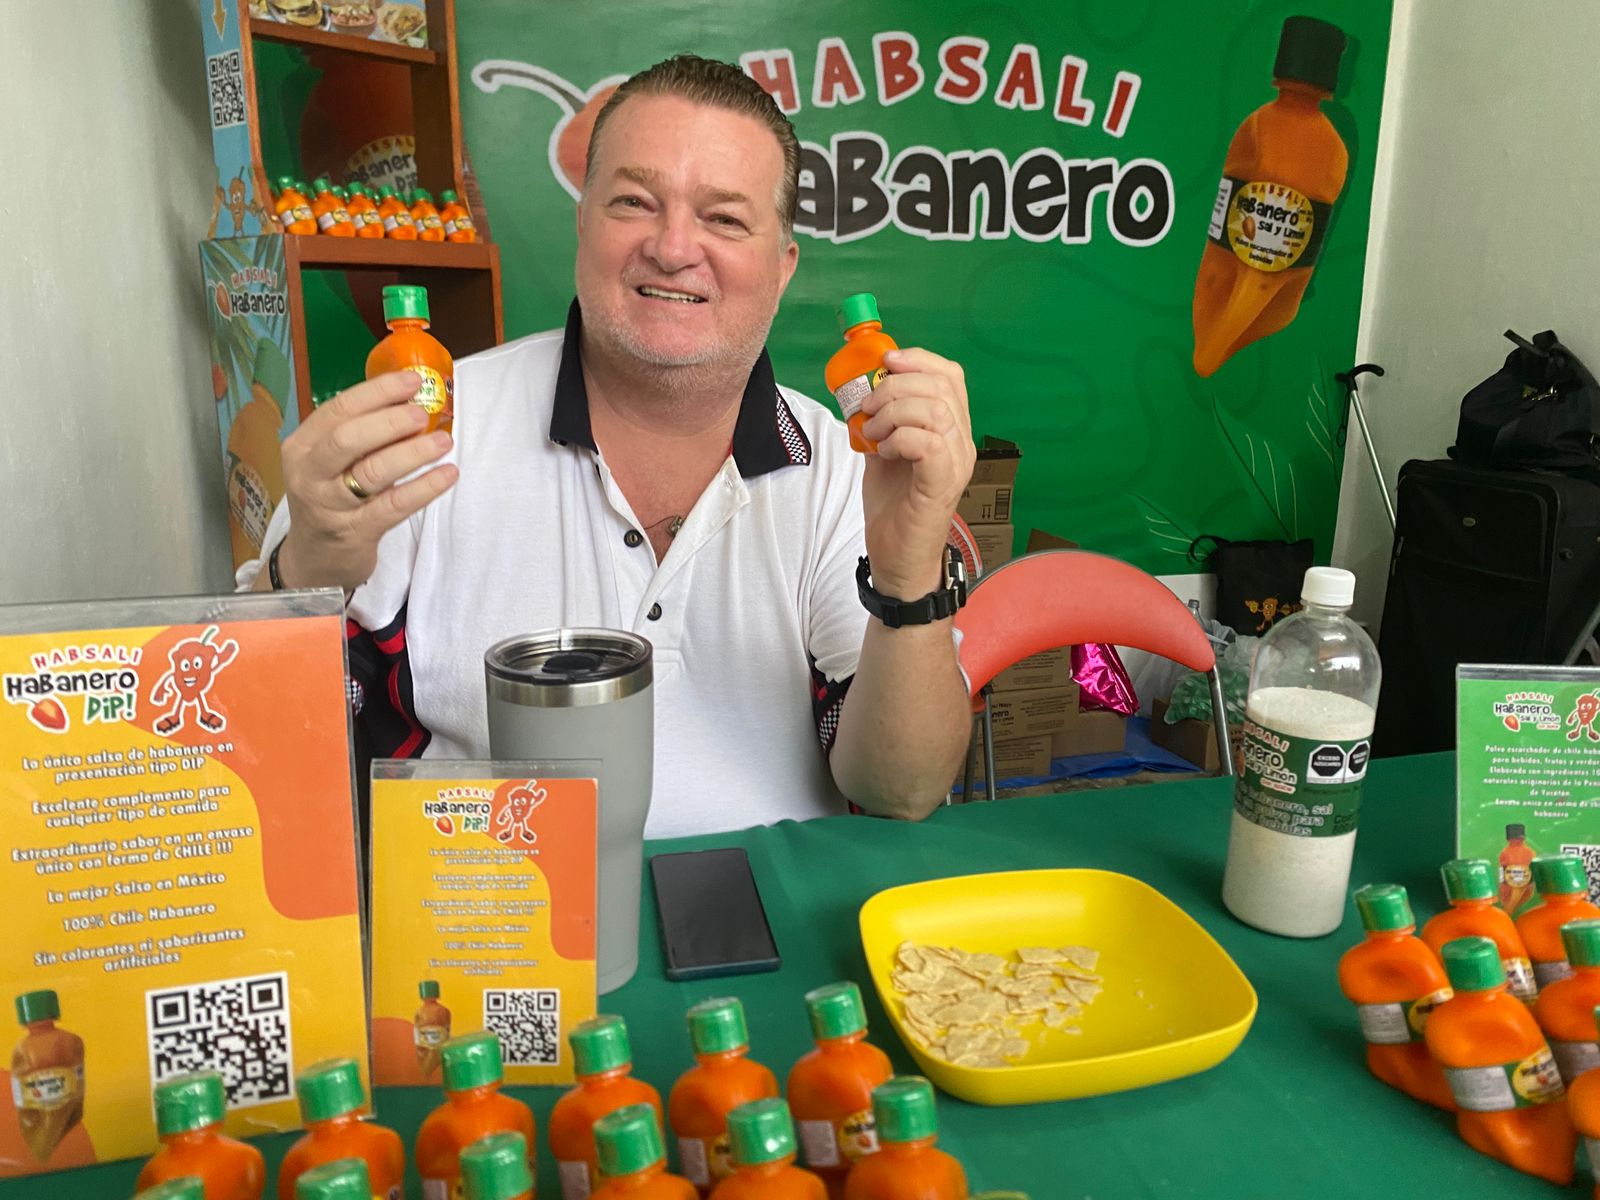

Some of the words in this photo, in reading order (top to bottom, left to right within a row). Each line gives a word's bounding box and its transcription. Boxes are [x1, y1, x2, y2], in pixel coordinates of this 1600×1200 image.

[743, 34, 1138, 136] HABSALI
[797, 133, 1172, 245] aBanero
[230, 293, 286, 315] HaBanero
[33, 646, 140, 669] HABSALI
[5, 671, 136, 697] HaBanero
[1494, 702, 1551, 715] HaBanero
[22, 758, 39, 770] La
[86, 750, 123, 765] salsa
[128, 748, 144, 760] de
[149, 744, 213, 760] habanero
[217, 742, 233, 752] en
[55, 762, 145, 785] presentación
[150, 761, 177, 775] tipo
[181, 757, 205, 770] DIP
[32, 799, 98, 815] Excelente
[103, 790, 194, 807] complemento
[199, 786, 230, 800] para
[46, 812, 112, 828] cualquier
[117, 808, 145, 823] tipo
[149, 804, 166, 817] de
[170, 799, 218, 815] comida
[424, 801, 491, 814] HaBanero
[12, 842, 117, 862] Extraordinario
[122, 837, 161, 850] sabor
[165, 835, 182, 845] en
[186, 832, 203, 842] un
[207, 827, 254, 840] envase
[78, 858, 102, 870] con
[107, 852, 148, 867] forma
[153, 849, 169, 861] de
[174, 843, 212, 859] CHILE
[47, 891, 64, 904] La
[68, 886, 109, 902] mejor
[114, 881, 152, 896] Salsa
[156, 880, 173, 890] en
[177, 872, 226, 888] México
[63, 914, 105, 932] 100%
[109, 911, 144, 926] Chile
[149, 903, 217, 921] Habanero
[34, 951, 57, 966] Sin
[62, 943, 135, 962] colorantes
[139, 938, 154, 951] ni
[158, 928, 247, 949] saborizantes
[104, 951, 180, 972] artificiales
